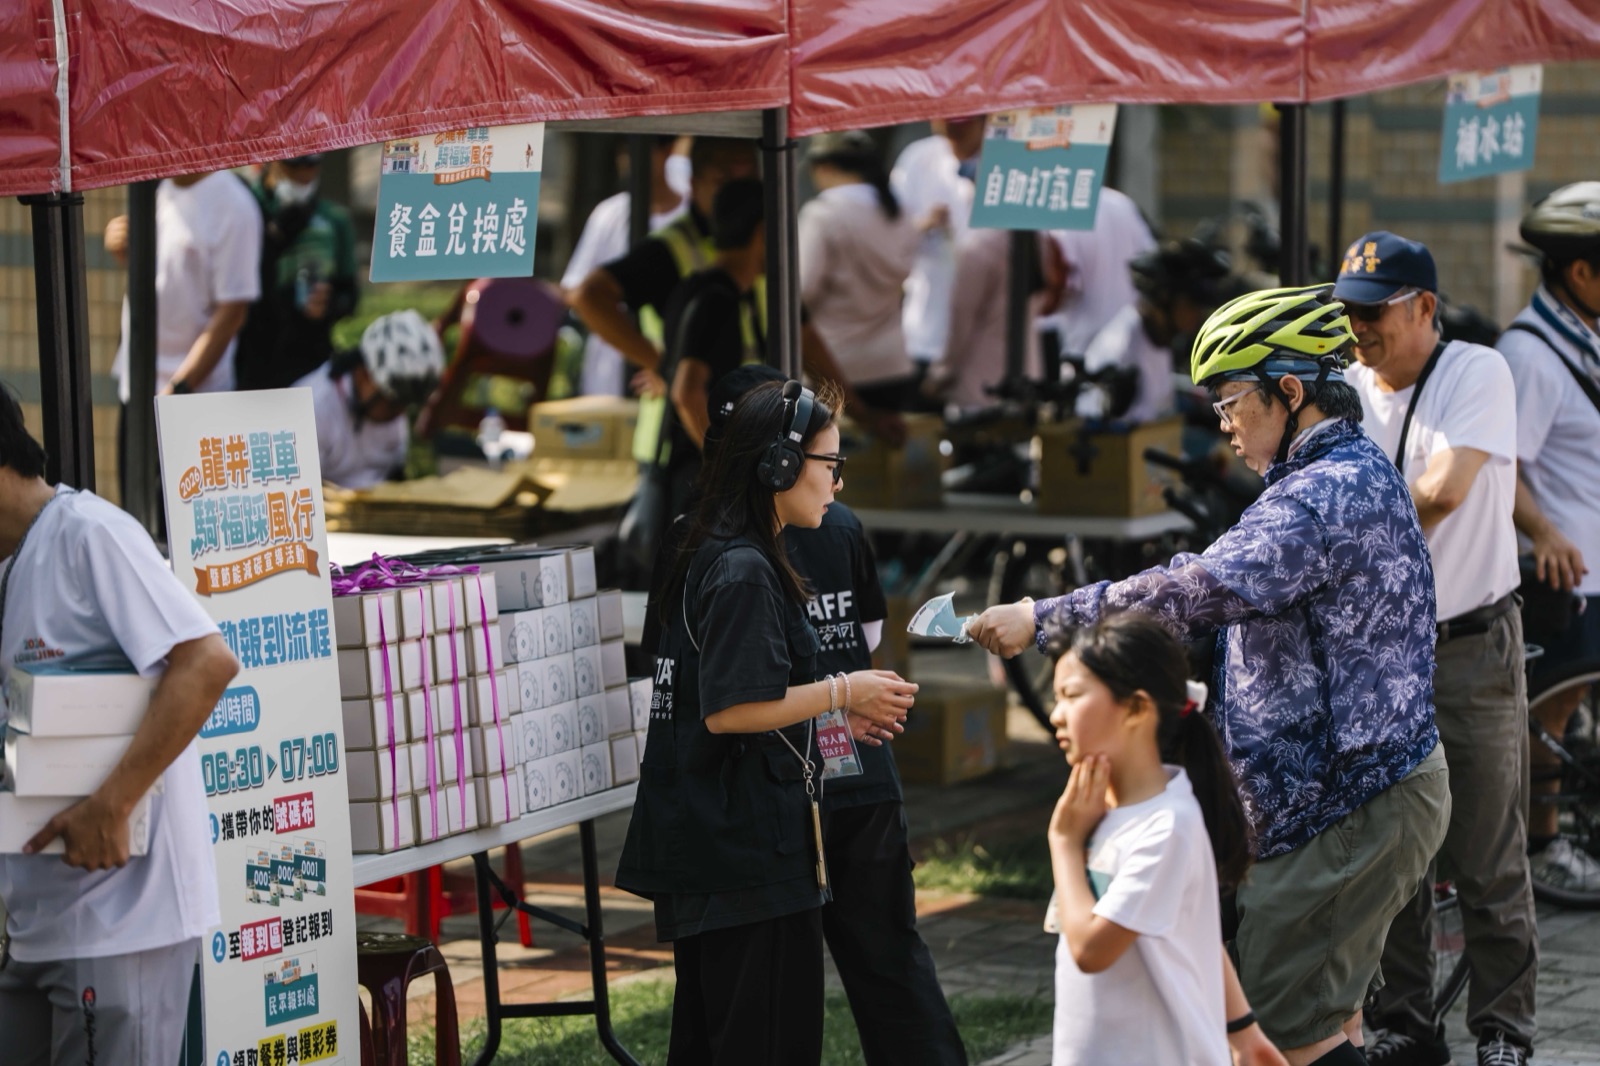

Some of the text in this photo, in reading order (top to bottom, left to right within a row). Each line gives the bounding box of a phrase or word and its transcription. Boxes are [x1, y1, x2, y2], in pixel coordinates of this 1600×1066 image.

[388, 198, 528, 258] 餐盒兌換處
[181, 430, 300, 498] 2026 龍井單車
[191, 487, 314, 556] 騎福踩風行
[201, 733, 339, 795] 06:30 07:00
[818, 733, 847, 747] 作人員
[820, 746, 845, 758] STAFF
[222, 797, 314, 841] 攜帶你的號碼布
[302, 861, 318, 877] 0001
[228, 909, 333, 959] 至報到區登記報到
